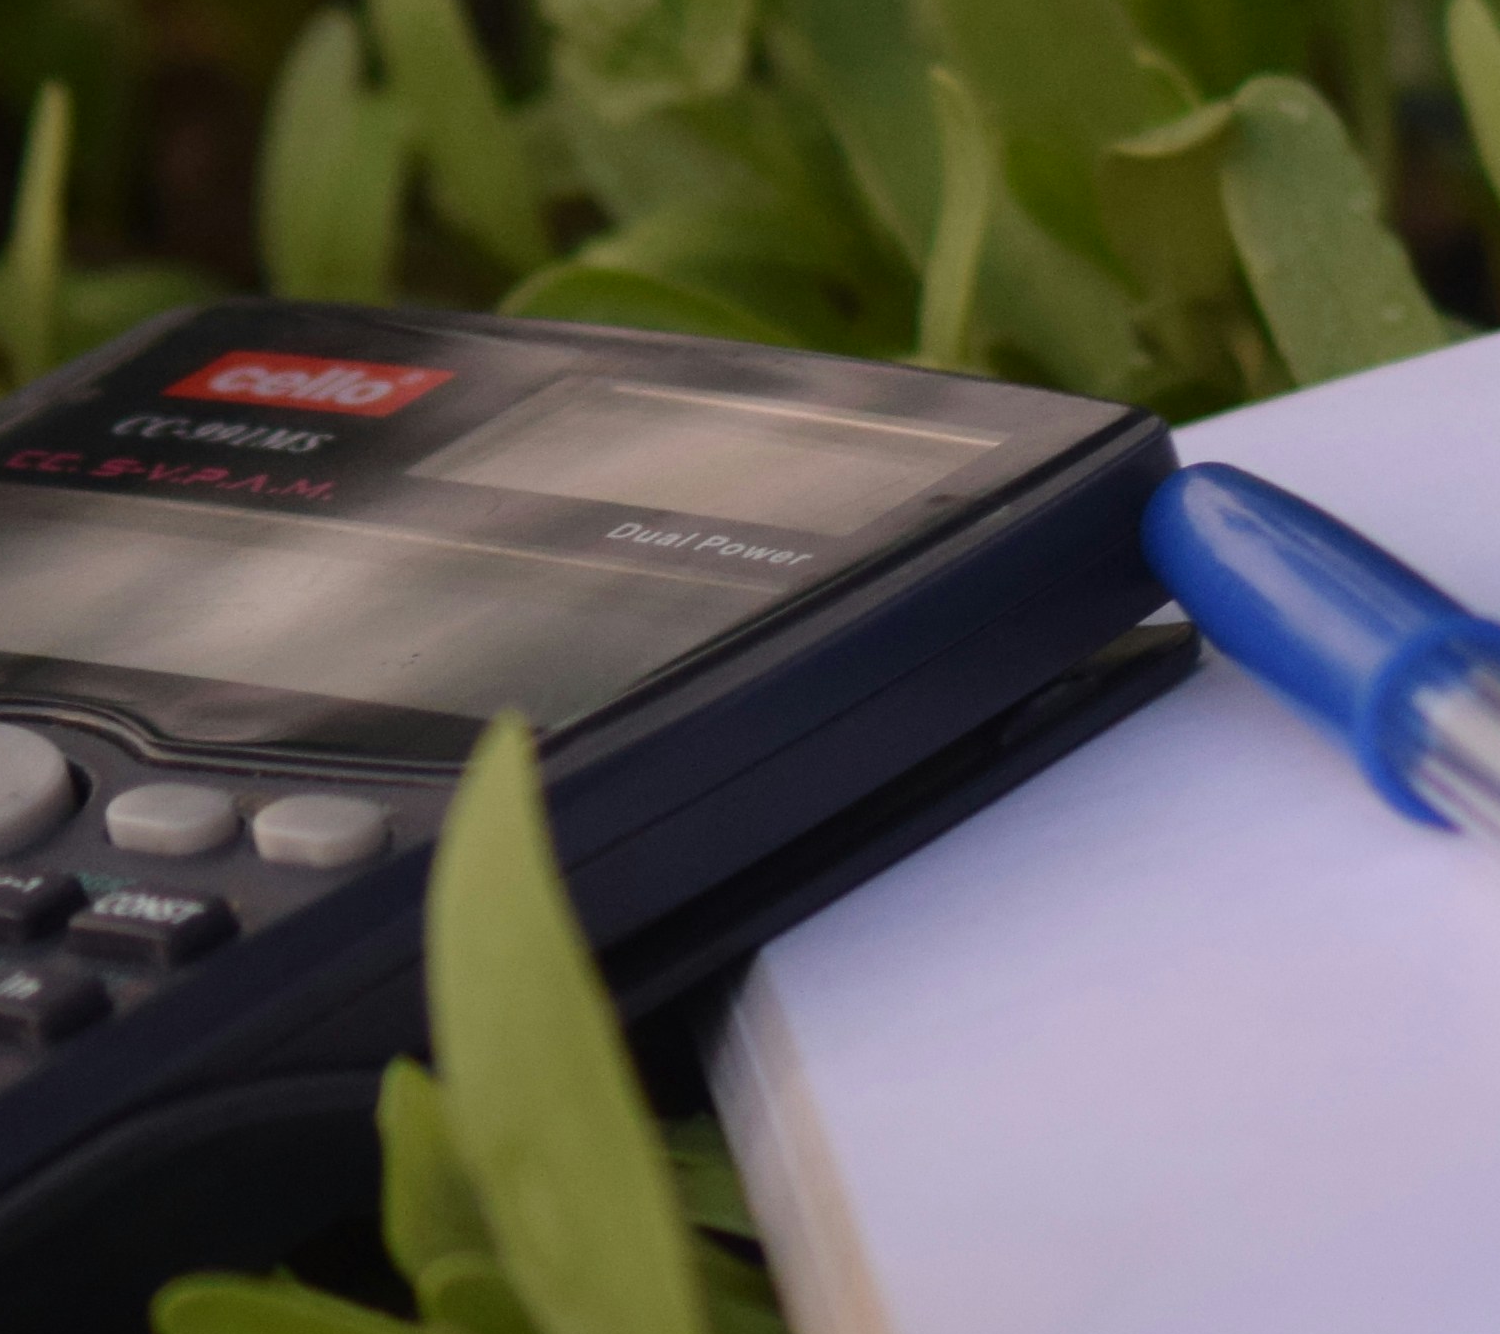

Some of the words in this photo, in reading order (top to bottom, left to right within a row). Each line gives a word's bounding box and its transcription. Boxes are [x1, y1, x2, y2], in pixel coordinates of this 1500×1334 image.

[207, 365, 394, 406] cello
[605, 521, 700, 549] Dual
[693, 534, 814, 567] Power
